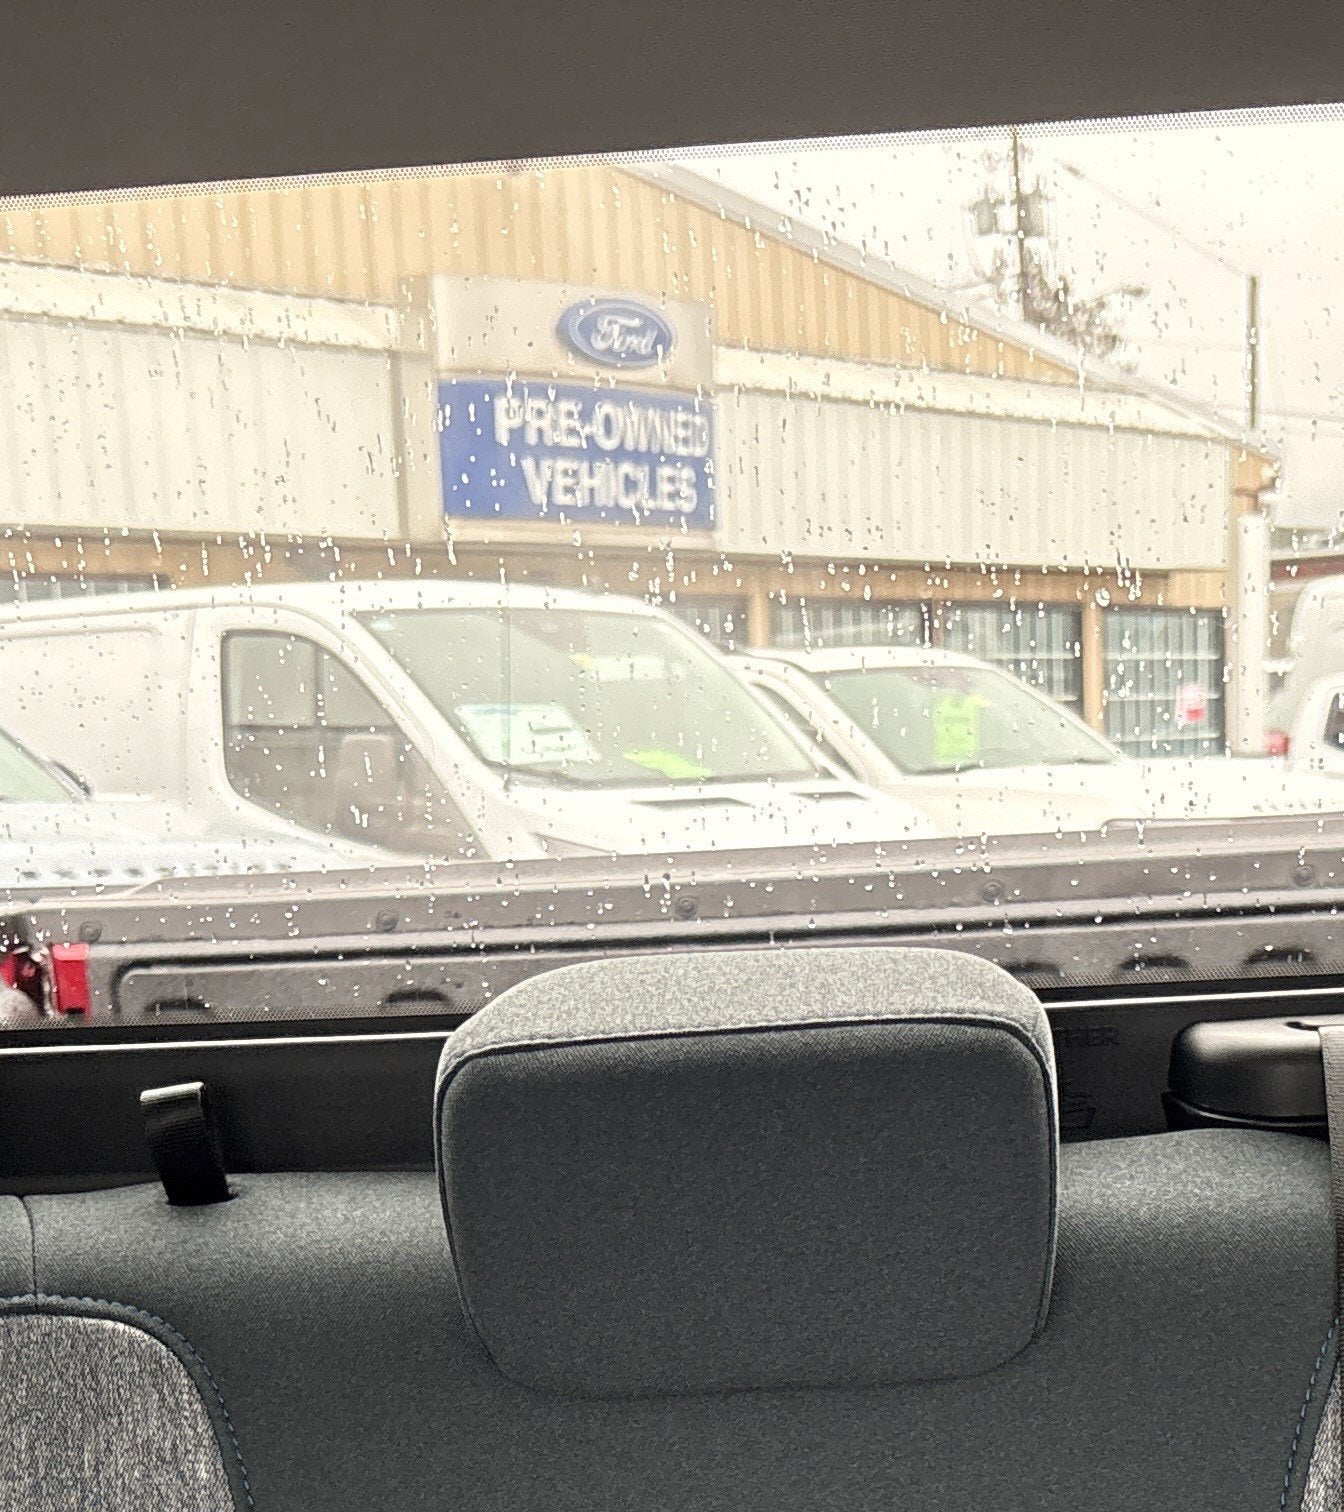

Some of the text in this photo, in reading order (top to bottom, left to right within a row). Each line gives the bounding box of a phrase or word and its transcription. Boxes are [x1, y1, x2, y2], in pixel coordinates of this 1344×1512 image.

[590, 313, 658, 355] Ford
[493, 396, 712, 458] PRE-OWNED
[520, 456, 699, 514] VEHICLES
